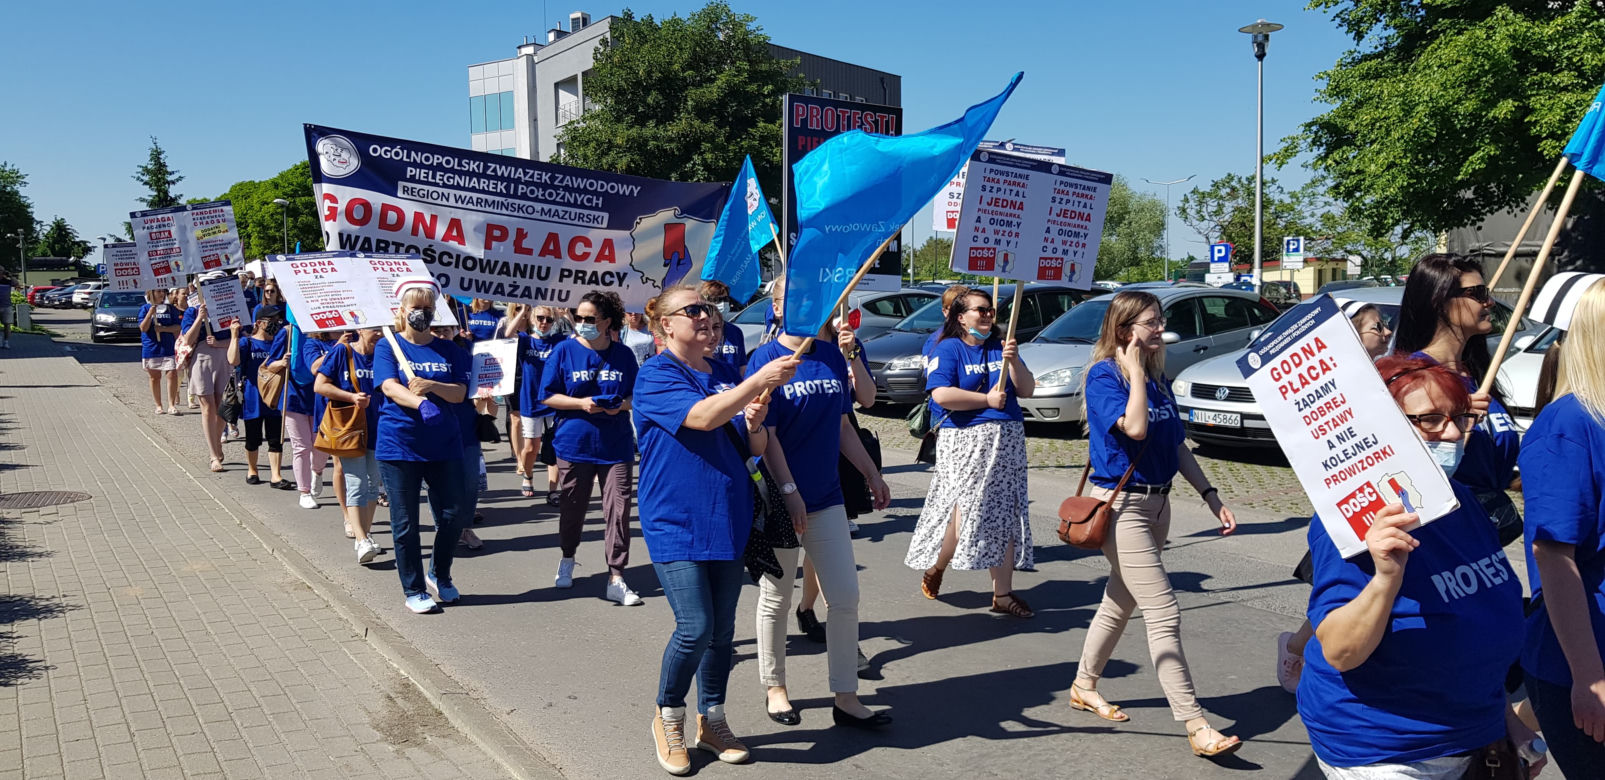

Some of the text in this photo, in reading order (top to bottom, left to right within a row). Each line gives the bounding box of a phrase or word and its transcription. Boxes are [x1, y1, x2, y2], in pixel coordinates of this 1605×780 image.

[794, 102, 896, 136] PROTEST!
[369, 144, 642, 197] OGÓLNOPOLSKI ZWIĄZEK ZAWODOWY
[989, 168, 1030, 180] POWSTANIE
[983, 176, 1000, 184] TAKA
[1059, 180, 1097, 193] POWSTANIE
[406, 167, 603, 208] PIELĘGNIAREK I POŁOŻNYCH
[981, 184, 1027, 198] SZPITAL
[1053, 188, 1070, 196] TAKA
[402, 185, 605, 226] REGION WARMIŃSKO-MAZURSKI
[979, 195, 1024, 211] I JEDNA
[1051, 196, 1093, 210] SZPITAL
[191, 208, 224, 216] PANDEMIA
[1049, 206, 1091, 223] I JEDNA
[193, 218, 226, 226] CHAOSU
[322, 193, 617, 264] GODNA PŁACA
[989, 218, 1022, 229] OIOM-Y
[151, 231, 169, 239] BRAK
[993, 228, 1020, 238] WZÓR
[1045, 226, 1088, 240] A OIOM-Y
[1061, 240, 1086, 249] WZÓR
[1289, 240, 1298, 251] P
[970, 248, 994, 257] DOŚĆ
[1214, 246, 1225, 261] P
[290, 260, 335, 269] GODNA
[338, 232, 551, 281] WARTOŚCIOWANIU
[558, 269, 630, 290] PRACY,
[1040, 258, 1062, 267] DOŚĆ
[100, 264, 106, 274] P
[116, 268, 139, 276] DOŚĆ
[294, 267, 338, 275] PŁACA
[459, 277, 571, 303] UWAŻANIU
[312, 310, 340, 320] DOŚĆ
[1270, 336, 1328, 383] GODNA
[1279, 356, 1338, 400] PŁACA:
[784, 379, 844, 400] PROTEST
[1294, 379, 1338, 413] ŻĄDAMY
[1303, 393, 1347, 426] DOBREJ
[1193, 411, 1239, 425] NIL 45866
[1311, 408, 1355, 440] USTAWY
[1327, 427, 1357, 450] A NIE
[1322, 433, 1379, 471] KOLEJNEJ
[1324, 444, 1395, 489] PROWIZORKI
[1340, 484, 1377, 518] DOŚĆ
